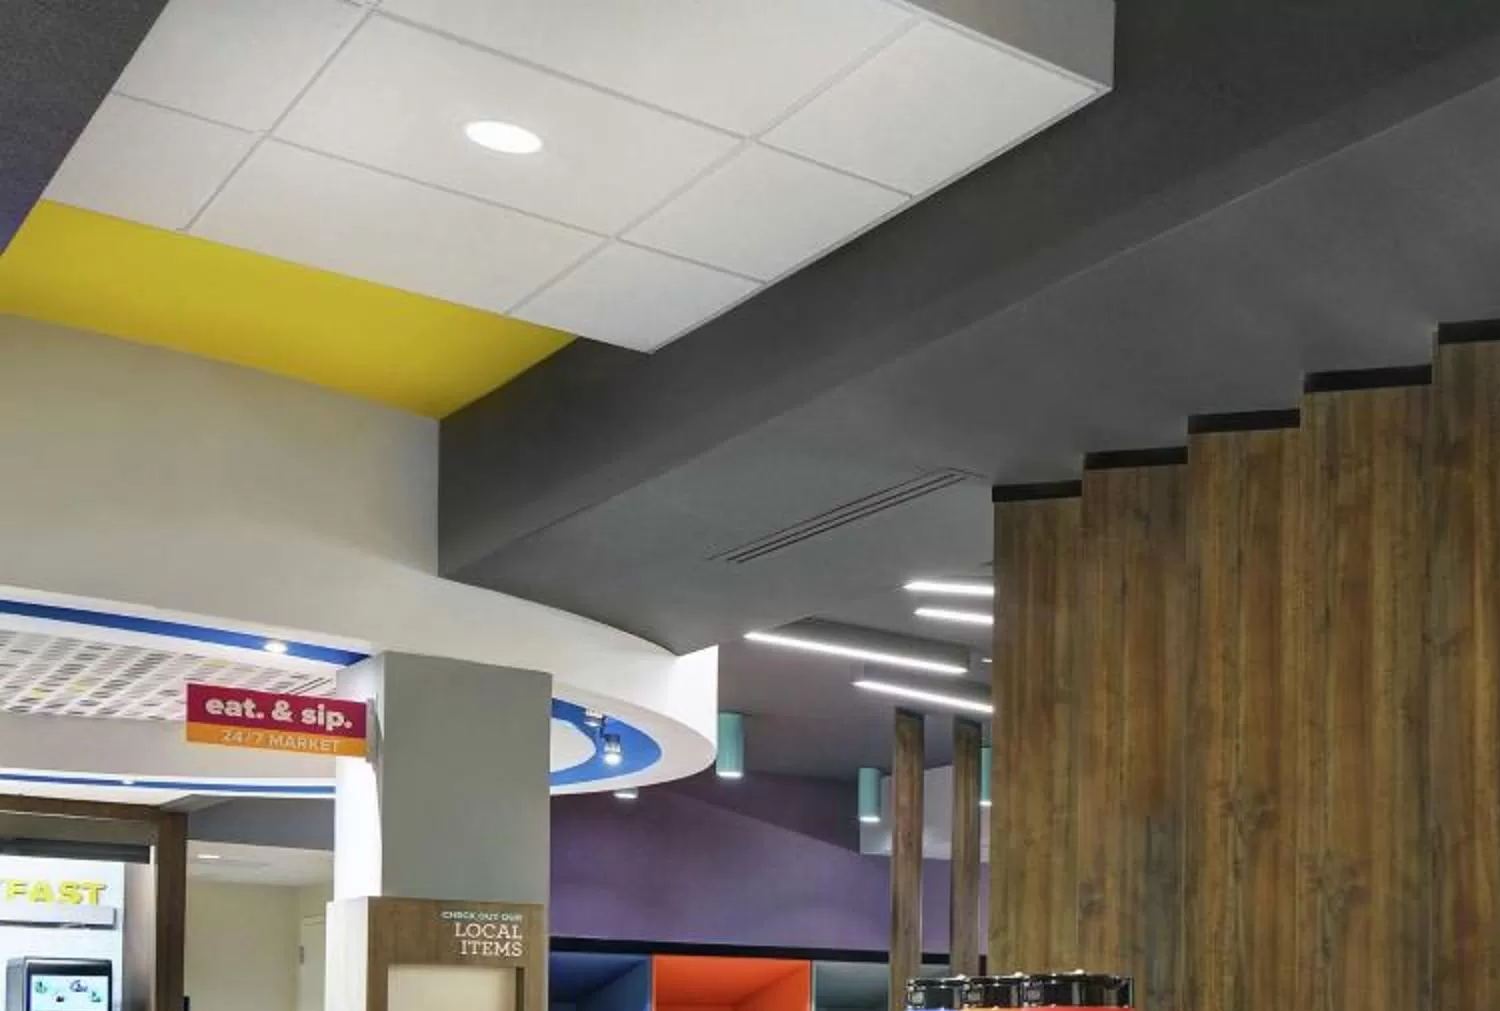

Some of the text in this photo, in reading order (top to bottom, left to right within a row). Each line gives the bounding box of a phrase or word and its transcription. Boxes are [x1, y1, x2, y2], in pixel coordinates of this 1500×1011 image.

[205, 698, 353, 731] eat. & sip.
[269, 735, 341, 753] MARKET
[0, 878, 107, 906] FAST
[454, 921, 523, 939] LOCAL
[459, 939, 523, 957] ITEMS
